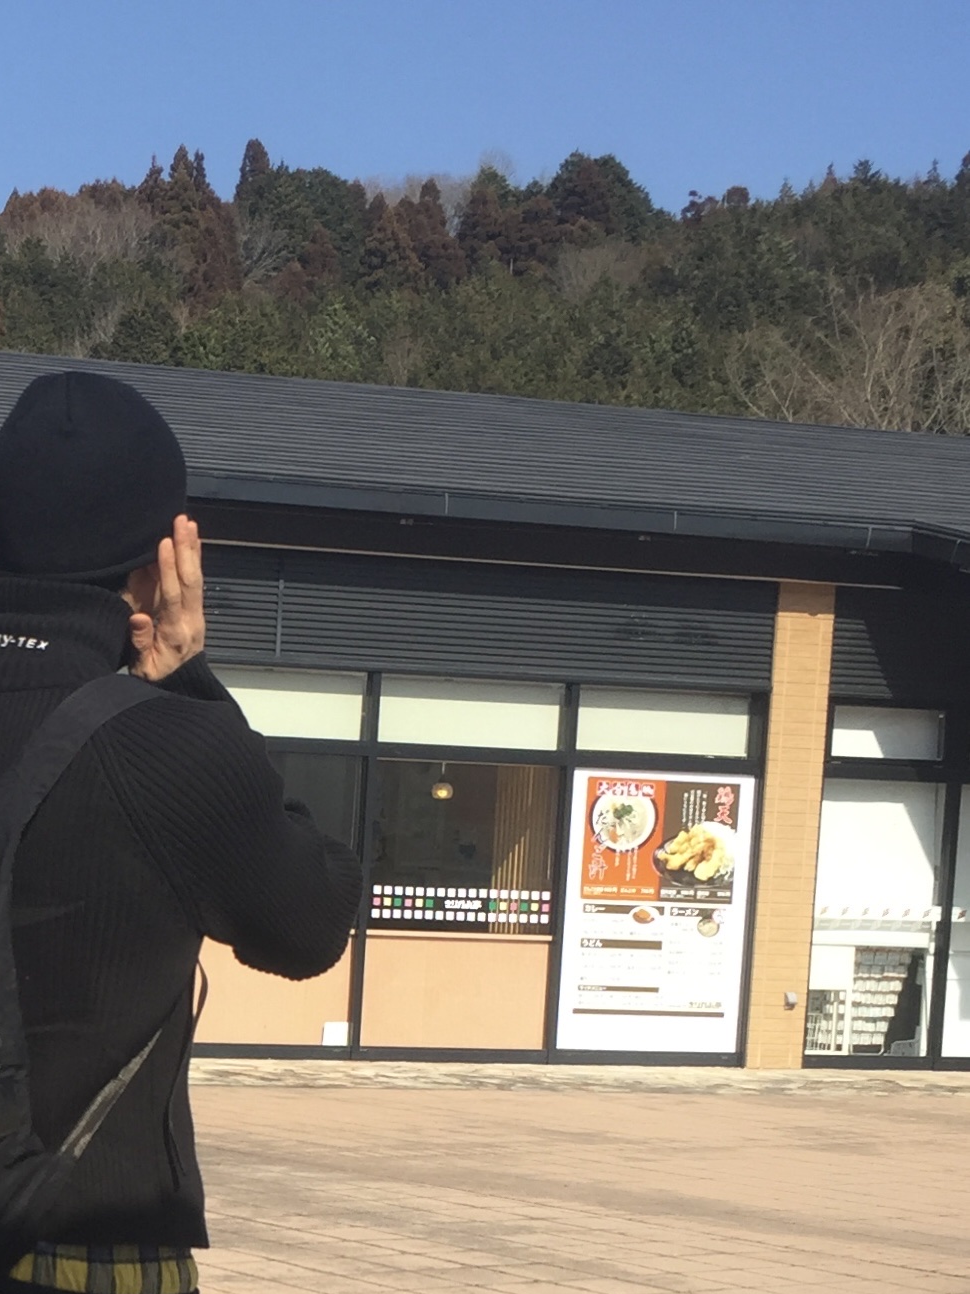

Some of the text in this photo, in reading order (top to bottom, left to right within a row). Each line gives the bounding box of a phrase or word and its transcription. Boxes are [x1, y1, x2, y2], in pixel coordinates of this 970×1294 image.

[671, 907, 700, 917] ラーメン
[581, 938, 603, 948] うどん
